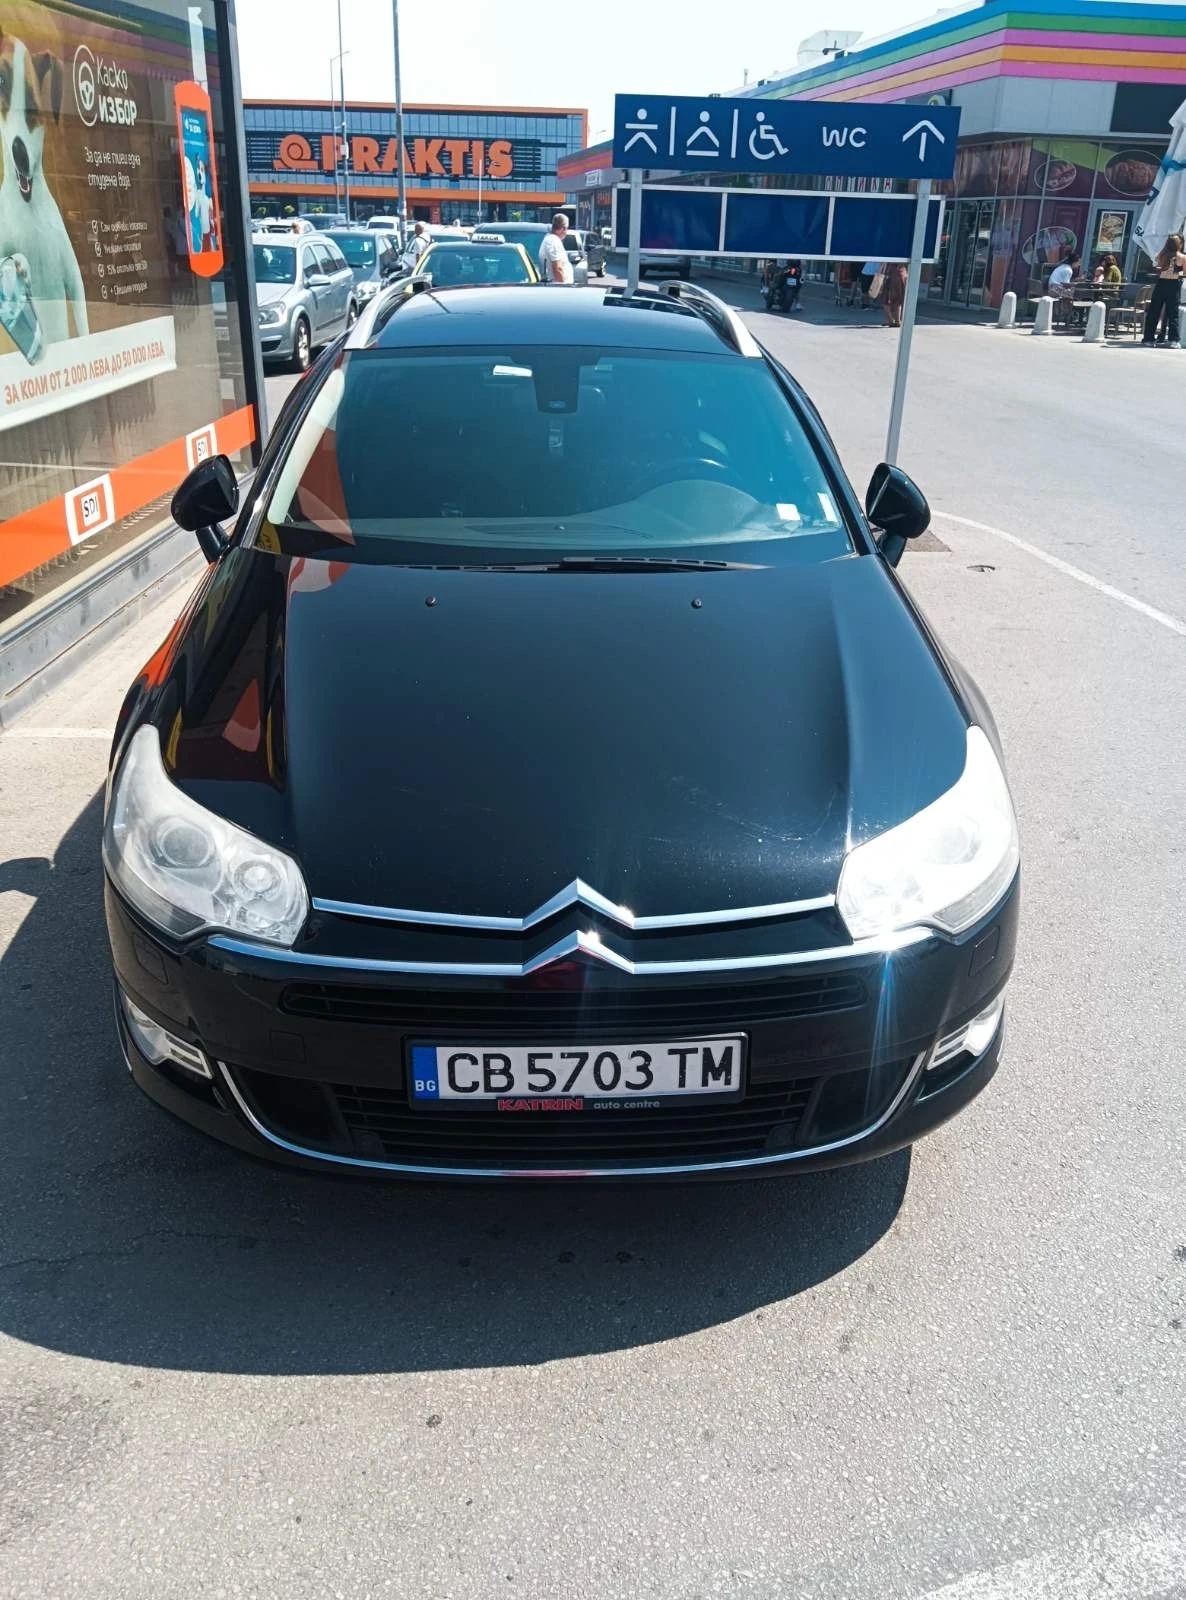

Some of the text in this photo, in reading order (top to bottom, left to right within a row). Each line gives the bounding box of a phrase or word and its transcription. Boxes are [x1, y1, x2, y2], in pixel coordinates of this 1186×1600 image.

[97, 55, 128, 90] Каско
[98, 94, 137, 126] ИЗБОР
[822, 126, 867, 148] WC
[103, 152, 112, 164] не
[321, 135, 514, 178] PRAKTIS
[4, 385, 20, 405] ЗА
[20, 375, 48, 400] КОЛИ
[50, 369, 61, 390] ОТ
[64, 367, 71, 388] 2
[71, 362, 88, 385] 000
[89, 357, 110, 380] ЛЕВА
[110, 354, 122, 376] ДО
[133, 345, 147, 365] 000
[147, 340, 165, 360] ЛЕВА
[83, 495, 99, 518] SDI
[415, 1046, 734, 1093] BG CB 5703 TM
[497, 1098, 661, 1111] KATRIN auto centre
